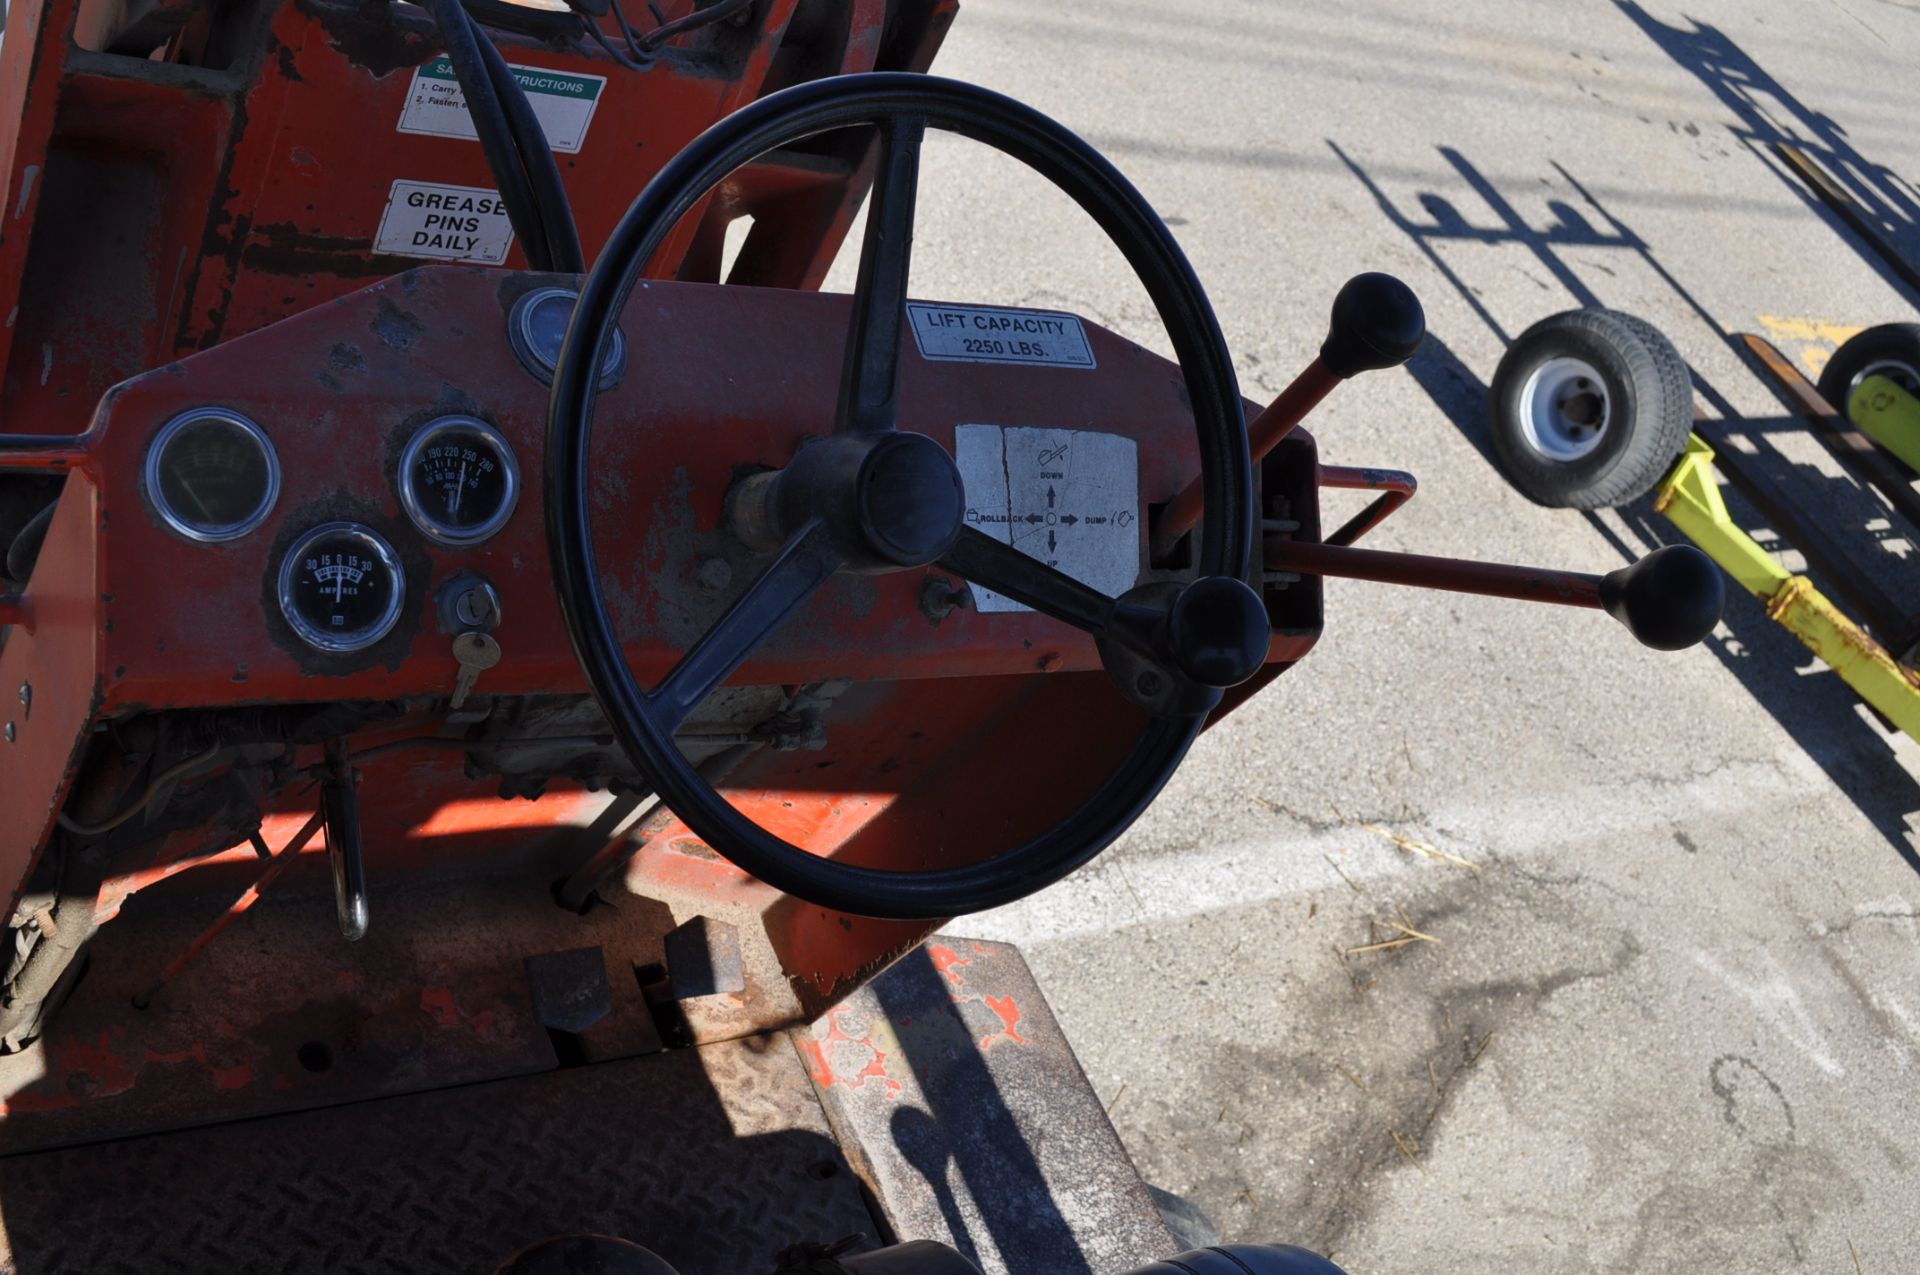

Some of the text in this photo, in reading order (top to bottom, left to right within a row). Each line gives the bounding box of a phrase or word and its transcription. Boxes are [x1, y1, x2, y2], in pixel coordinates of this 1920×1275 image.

[432, 84, 456, 95] Carry
[514, 74, 584, 93] TRUCTIONS
[428, 97, 459, 107] Fasten
[408, 192, 506, 215] GREASE
[425, 214, 480, 232] PINS
[412, 231, 480, 251] DAILY
[927, 313, 1064, 335] LIFT CAPACITY
[963, 339, 1049, 357] 2250 LBS.
[444, 447, 459, 457] 220
[1040, 472, 1063, 480] DOWN
[980, 515, 1023, 523] ROLLBACK
[1085, 516, 1107, 524] DUMP
[306, 559, 318, 570] 30
[321, 554, 331, 566] 15
[348, 555, 358, 567] 15
[361, 560, 372, 572] 30
[319, 587, 358, 596] AMPRES
